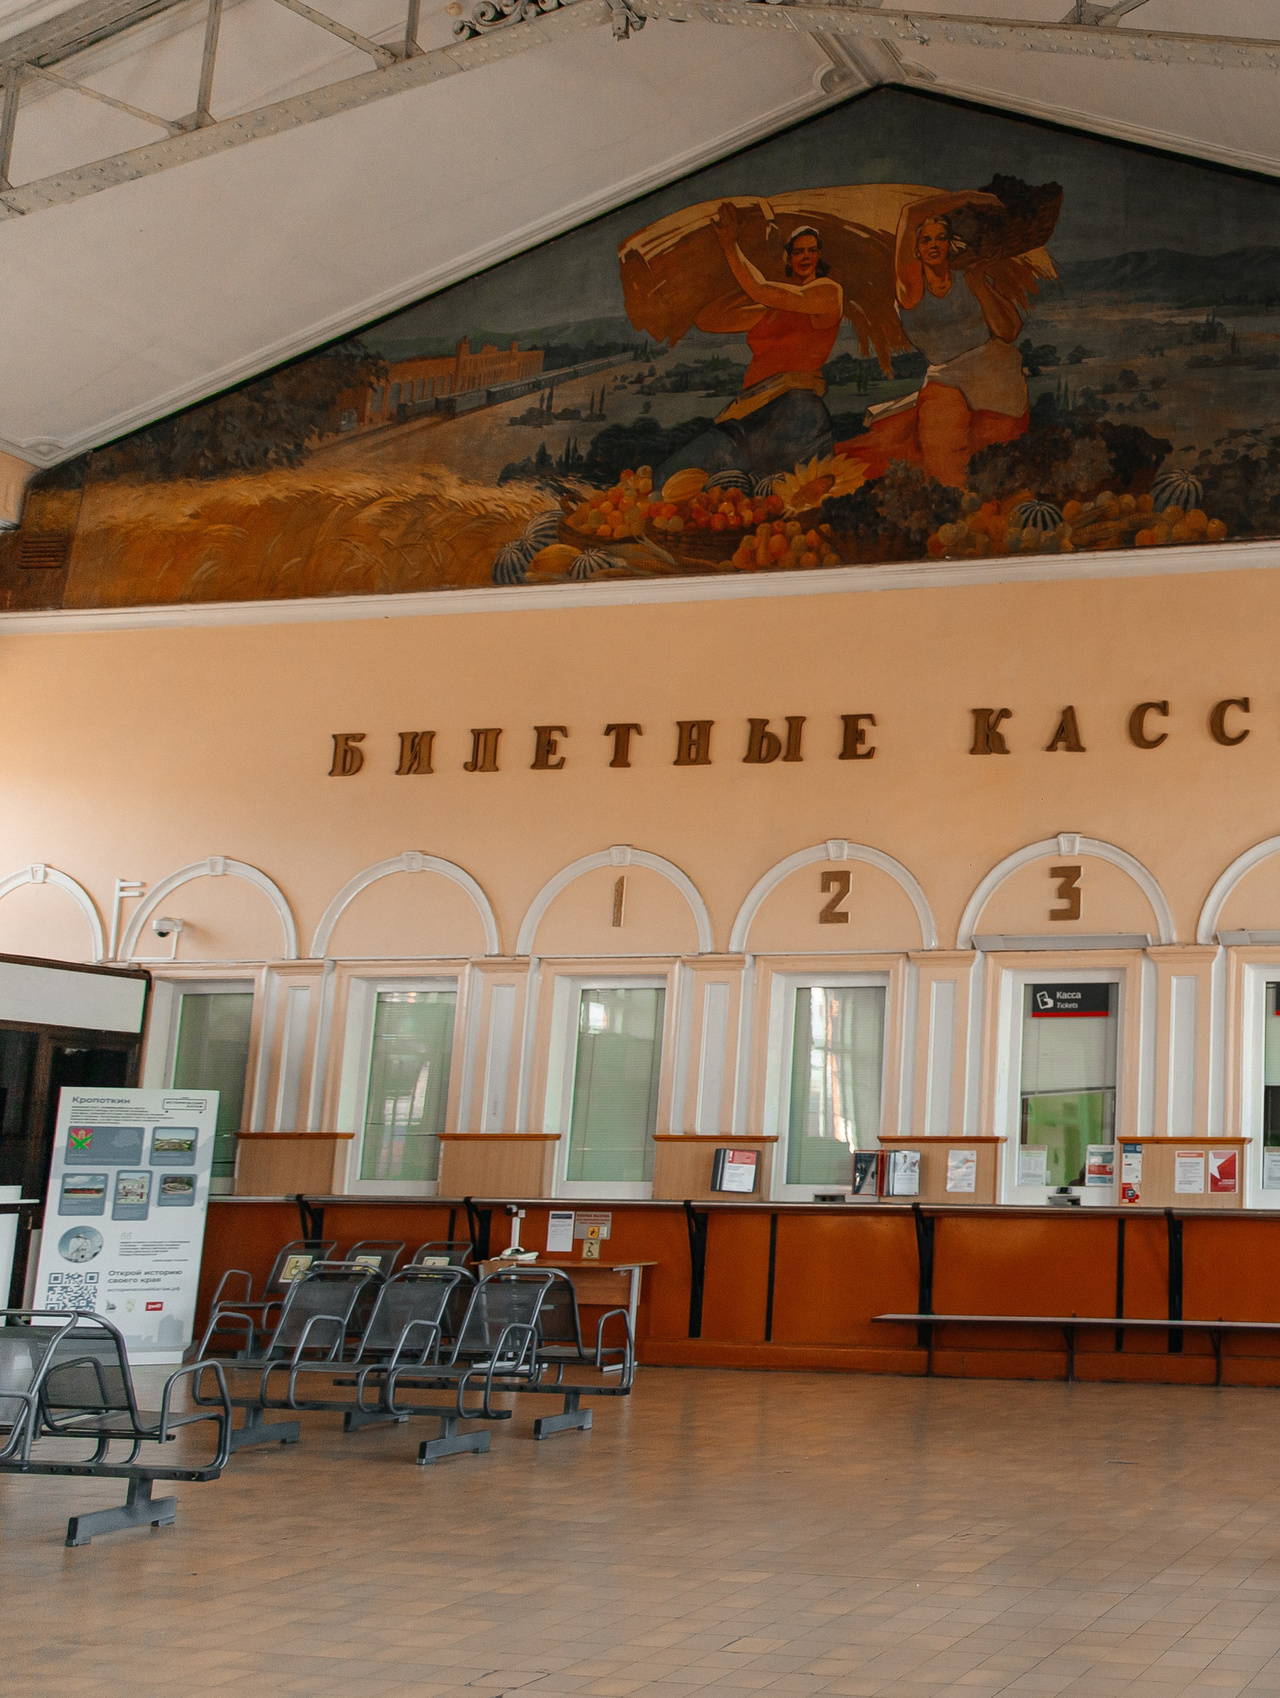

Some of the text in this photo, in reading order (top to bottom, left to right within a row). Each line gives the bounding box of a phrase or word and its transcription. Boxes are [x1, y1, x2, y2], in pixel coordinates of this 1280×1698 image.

[328, 713, 877, 777] БИЛЕТНЫЕ
[612, 876, 627, 927] 1
[819, 870, 851, 924] 2
[1050, 866, 1082, 921] 3
[1056, 991, 1082, 999] Касса
[72, 1096, 131, 1104] Кропоткин
[108, 1269, 142, 1277] Открой
